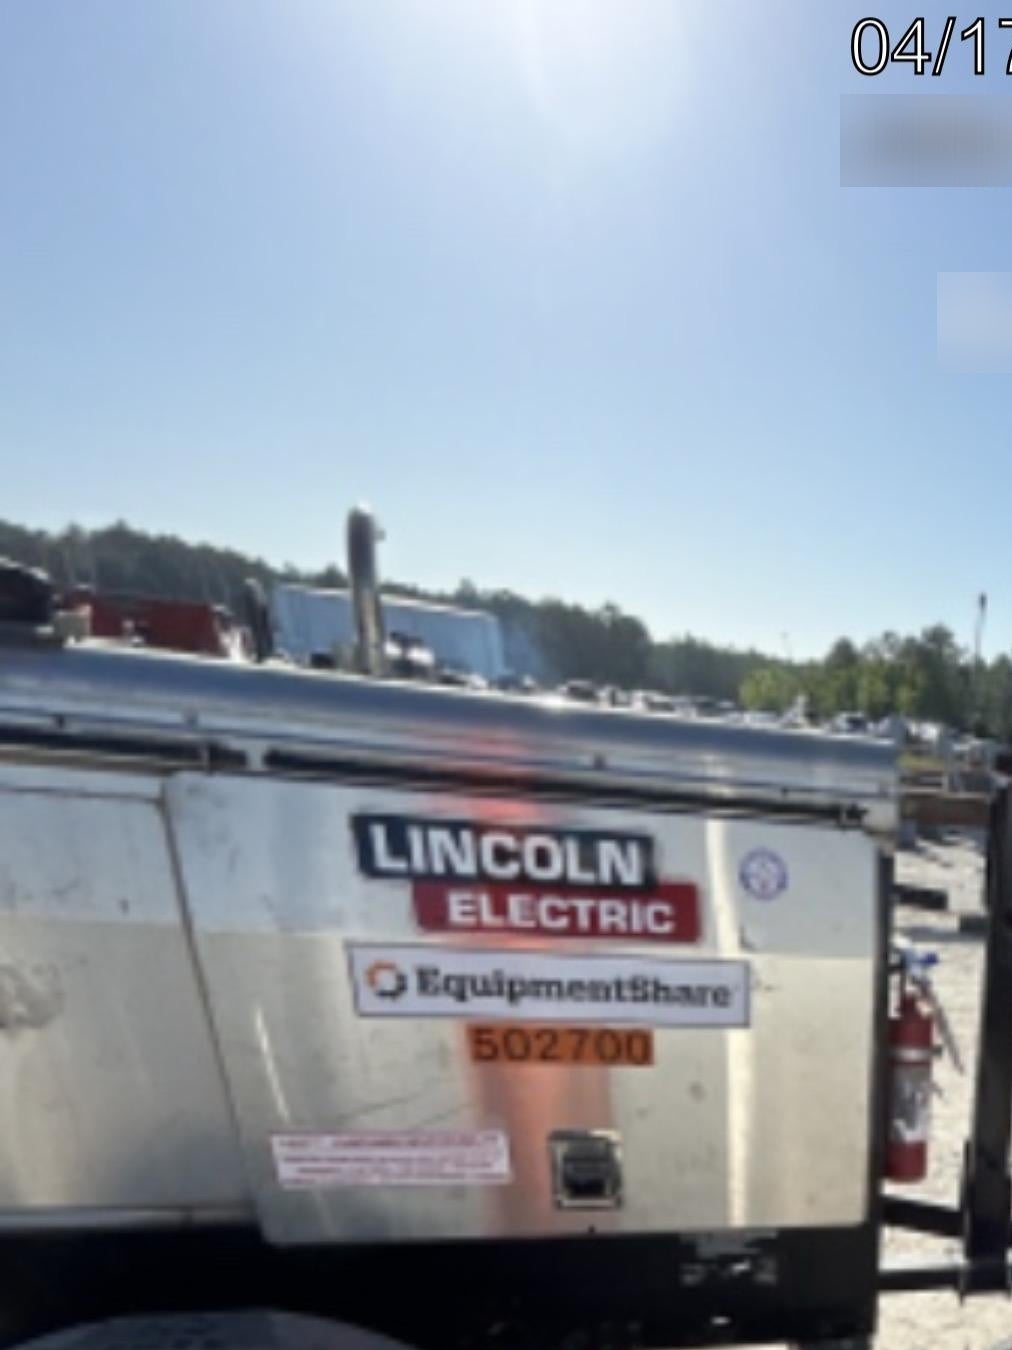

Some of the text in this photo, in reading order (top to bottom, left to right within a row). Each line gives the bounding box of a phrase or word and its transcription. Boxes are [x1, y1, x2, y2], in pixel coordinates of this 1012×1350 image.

[368, 823, 643, 886] LINCOLN
[448, 892, 675, 934] ELECTRIC
[416, 966, 733, 1008] EquipmentShare
[470, 1028, 653, 1064] 502700
